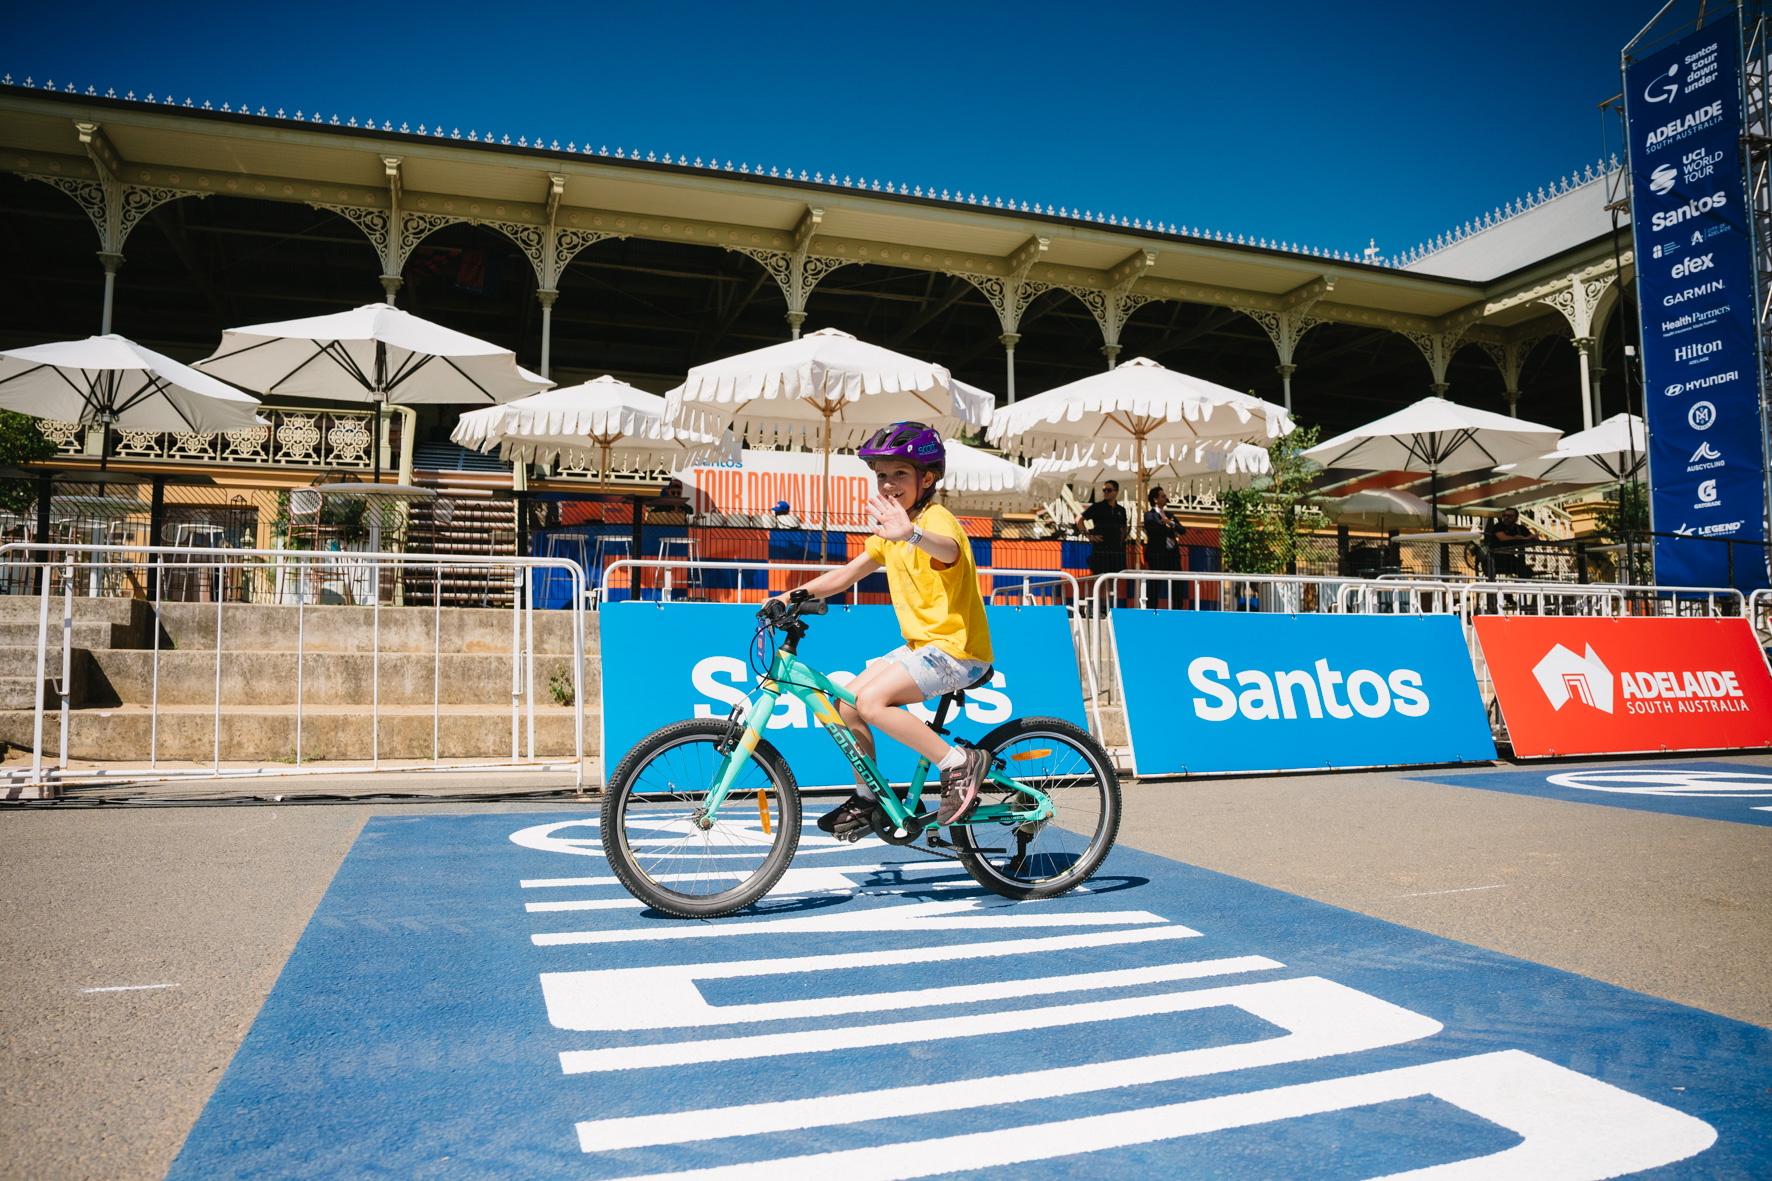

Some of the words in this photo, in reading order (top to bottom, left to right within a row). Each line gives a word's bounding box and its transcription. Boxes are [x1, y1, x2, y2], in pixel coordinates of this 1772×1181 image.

[1684, 43, 1718, 64] Santos
[1692, 53, 1717, 71] tour
[1685, 72, 1718, 93] under
[1687, 62, 1717, 82] down
[1646, 100, 1722, 147] ADELAIDE
[1646, 139, 1673, 155] SOUTH
[1676, 115, 1723, 141] AUSTRALIA
[1682, 148, 1705, 164] UCI
[1683, 151, 1723, 174] WORLD
[1684, 166, 1714, 184] TOUR
[1652, 191, 1727, 232] Santos
[1671, 253, 1714, 279] efex
[1663, 279, 1723, 306] GARMIN
[1662, 315, 1692, 331] Health
[1693, 305, 1730, 322] Partners
[1675, 340, 1722, 361] Hilton
[1686, 371, 1738, 391] HYUNDAI
[1687, 460, 1725, 472] AUSCYCLING
[694, 469, 743, 519] TOUR
[748, 472, 806, 524] DOWN
[810, 475, 869, 526] UNDER
[1698, 522, 1740, 535] LEGEND
[1188, 657, 1430, 721] Santos
[1621, 671, 1744, 699] ADELAIDE
[1626, 701, 1674, 714] SOUTH
[1678, 699, 1750, 713] AUSTRALIA
[825, 722, 881, 793] POLYGON
